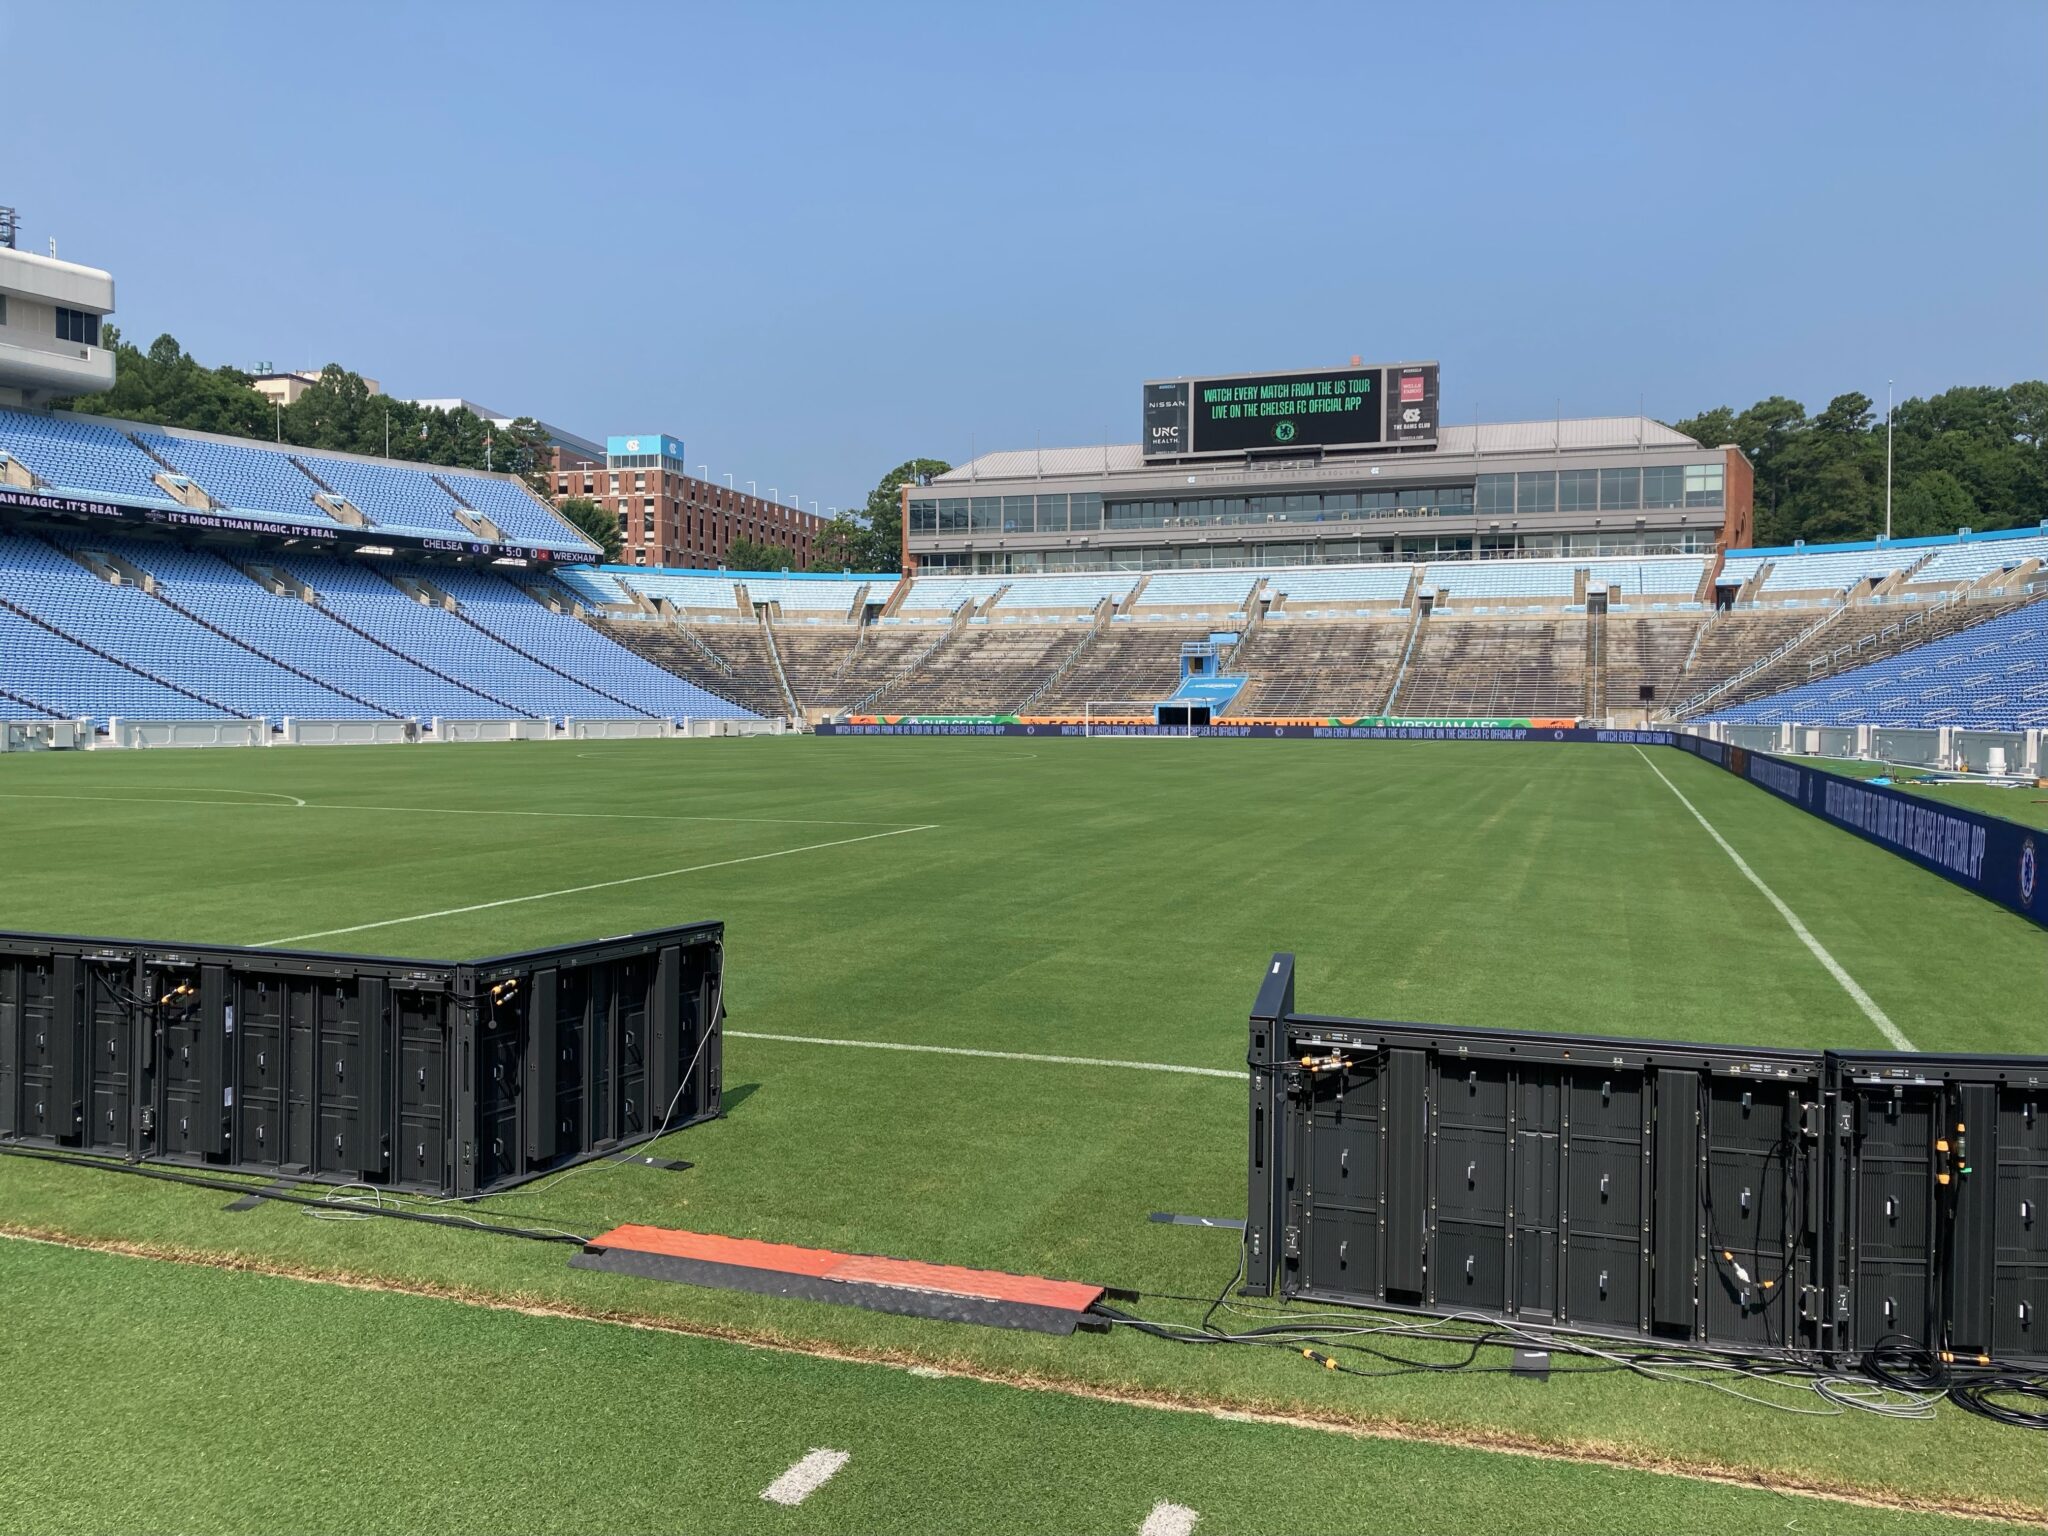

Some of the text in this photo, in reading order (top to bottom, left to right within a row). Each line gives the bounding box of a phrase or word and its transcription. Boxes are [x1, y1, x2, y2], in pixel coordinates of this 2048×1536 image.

[1204, 378, 1370, 403] WATCH EVERY MATCH FROM THE US TOUR
[1149, 400, 1185, 408] NISSAN
[1212, 396, 1362, 420] LIVE ON THE CHELSEA FC OFFICIAL APP
[1152, 426, 1179, 437] UNC
[19, 496, 64, 509] MAGIC.
[66, 501, 87, 512] IT'S
[90, 504, 123, 516] REAL.
[168, 513, 338, 539] IT'S MORE THAN MAGIC. IT'S REAL.
[423, 539, 489, 554] CHELSEA 0
[506, 547, 522, 557] 5:0
[531, 549, 596, 562] 0 WREXHAM
[950, 726, 969, 735] CHELSEA
[976, 726, 994, 735] OFFICIAL
[995, 726, 1005, 735] APP
[1061, 726, 1078, 735] WATCH
[1079, 726, 1093, 735] EVRY
[1211, 726, 1217, 736] FC
[1218, 726, 1239, 736] OFFICIAL
[1240, 727, 1250, 736] APP
[1314, 728, 1526, 740] WATCH EVERY MATCH FROM THE US TOUR LIVE ON THE CHELSEA FC OFFICIAL APP
[1597, 731, 1617, 742] WATCH
[1619, 731, 1636, 742] EVERY
[1653, 732, 1665, 743] FROM
[1944, 816, 1970, 875] OFFICIAL
[1970, 824, 1986, 880] APP
